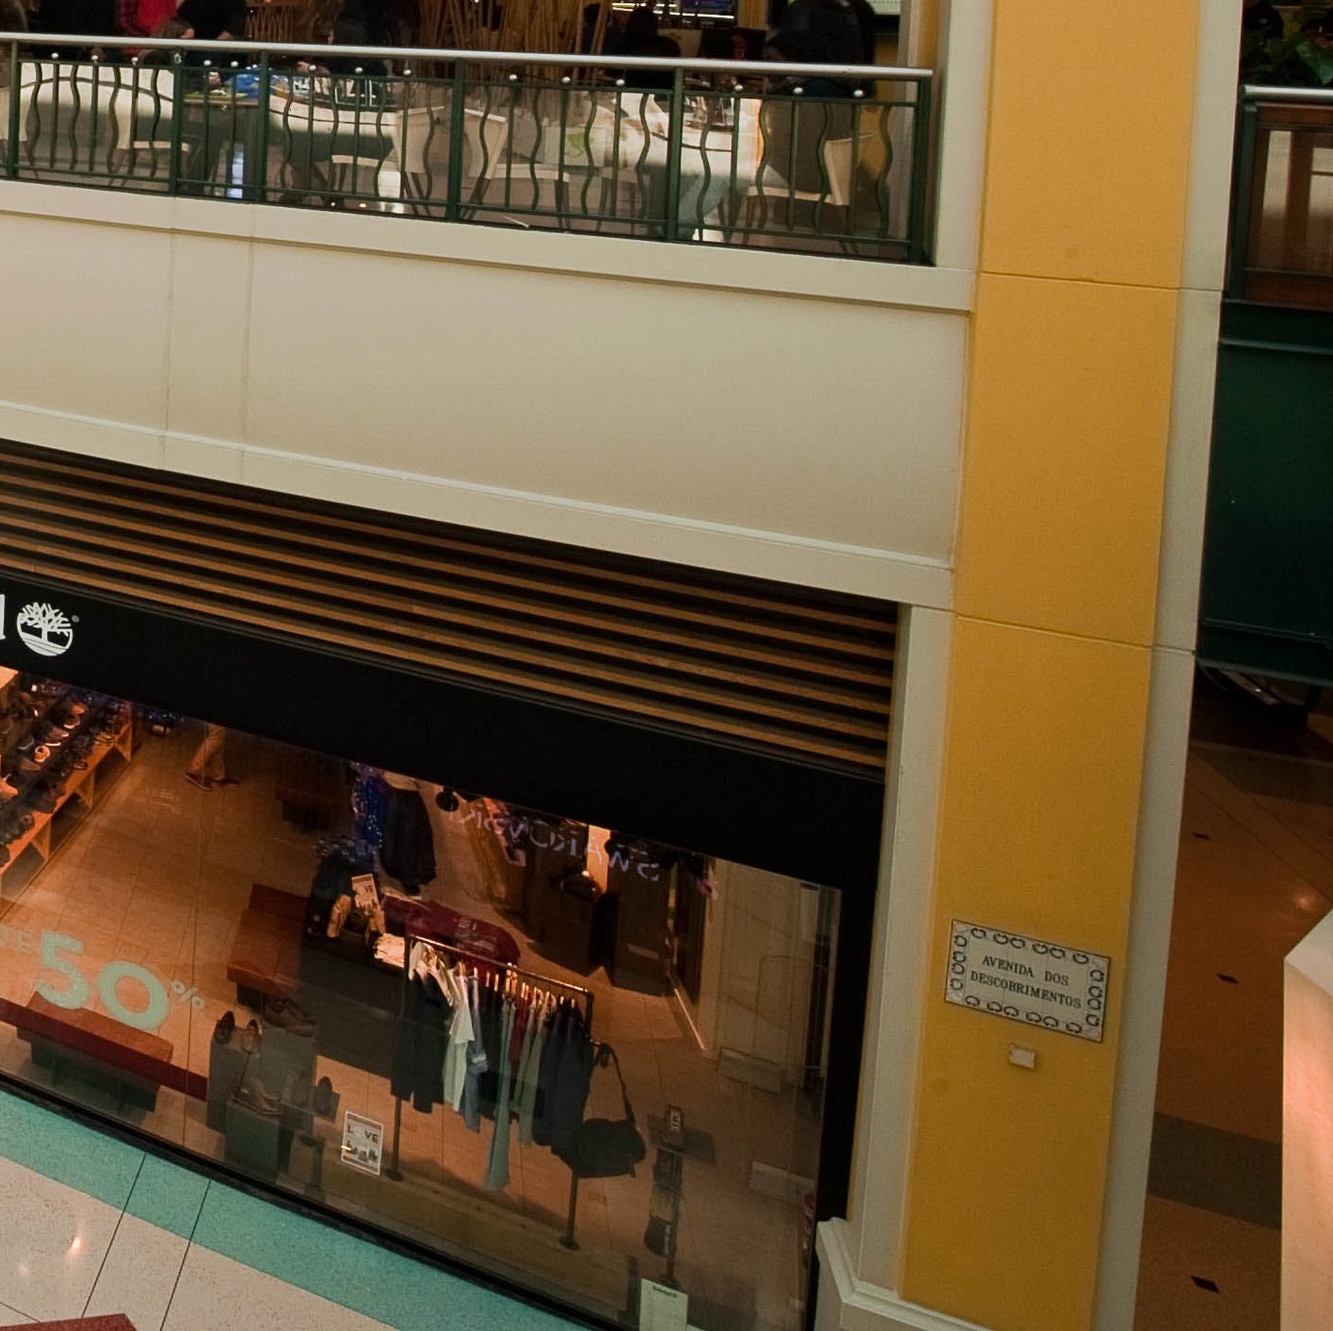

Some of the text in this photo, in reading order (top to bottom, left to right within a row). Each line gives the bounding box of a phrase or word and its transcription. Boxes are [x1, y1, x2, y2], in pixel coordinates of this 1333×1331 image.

[982, 955, 1070, 986] AVENIDA DOS
[970, 970, 1083, 1009] DESCOBRIMENTOS
